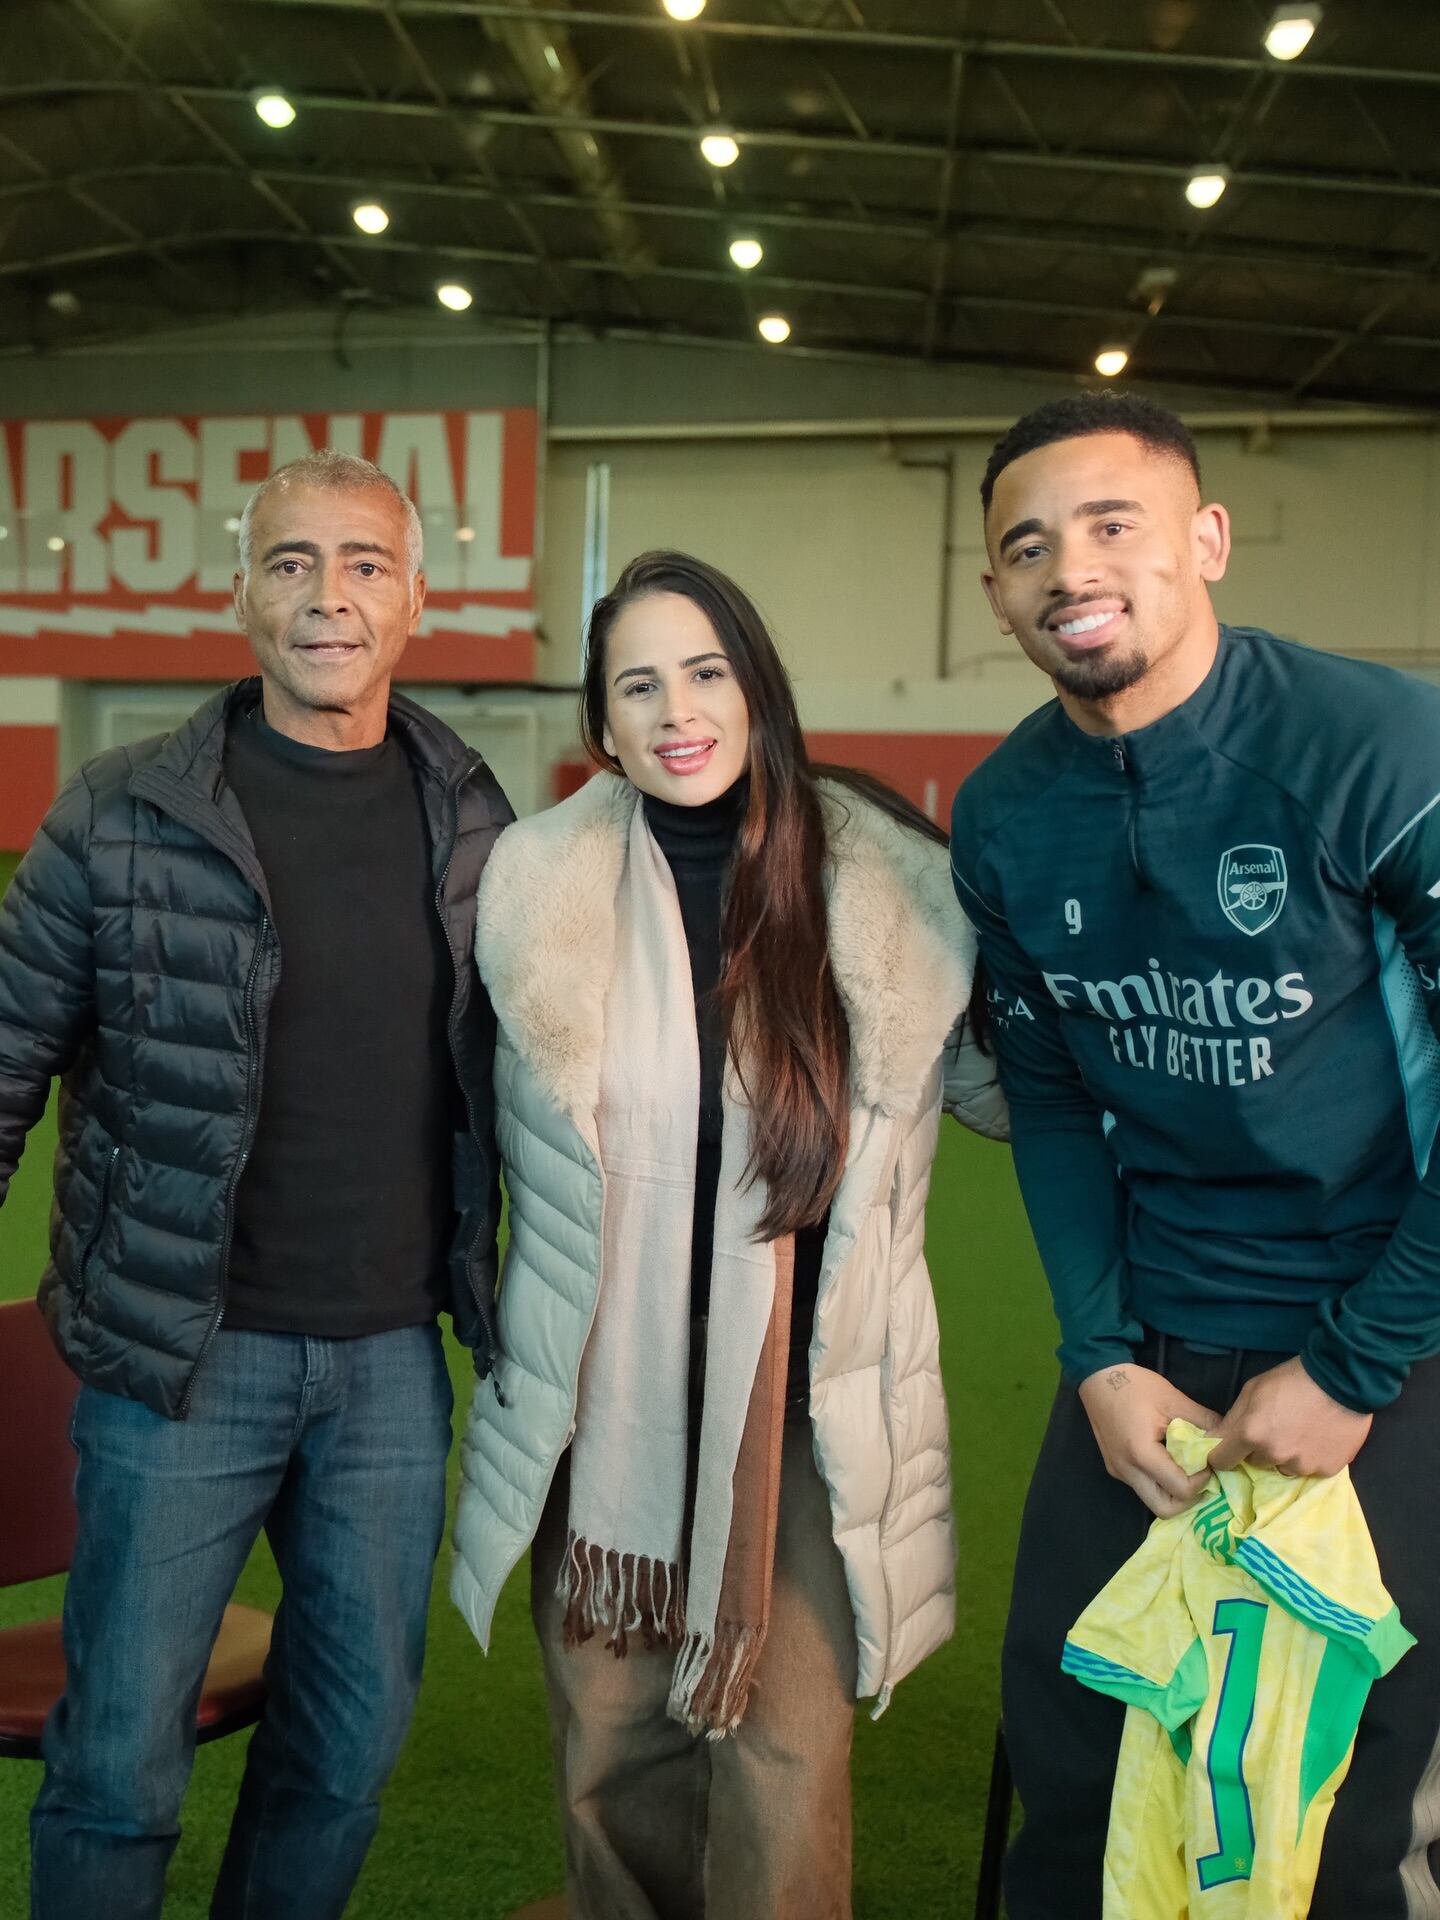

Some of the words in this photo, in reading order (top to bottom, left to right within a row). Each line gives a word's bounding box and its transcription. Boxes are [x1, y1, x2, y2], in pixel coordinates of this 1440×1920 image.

[0, 412, 533, 593] RSEAL
[1229, 860, 1275, 875] Arsenal
[1064, 898, 1082, 935] 9
[1041, 957, 1314, 1028] Emirates
[1109, 1025, 1157, 1070] FLY
[1166, 1029, 1275, 1087] BETTER
[1195, 1598, 1269, 1892] 1
